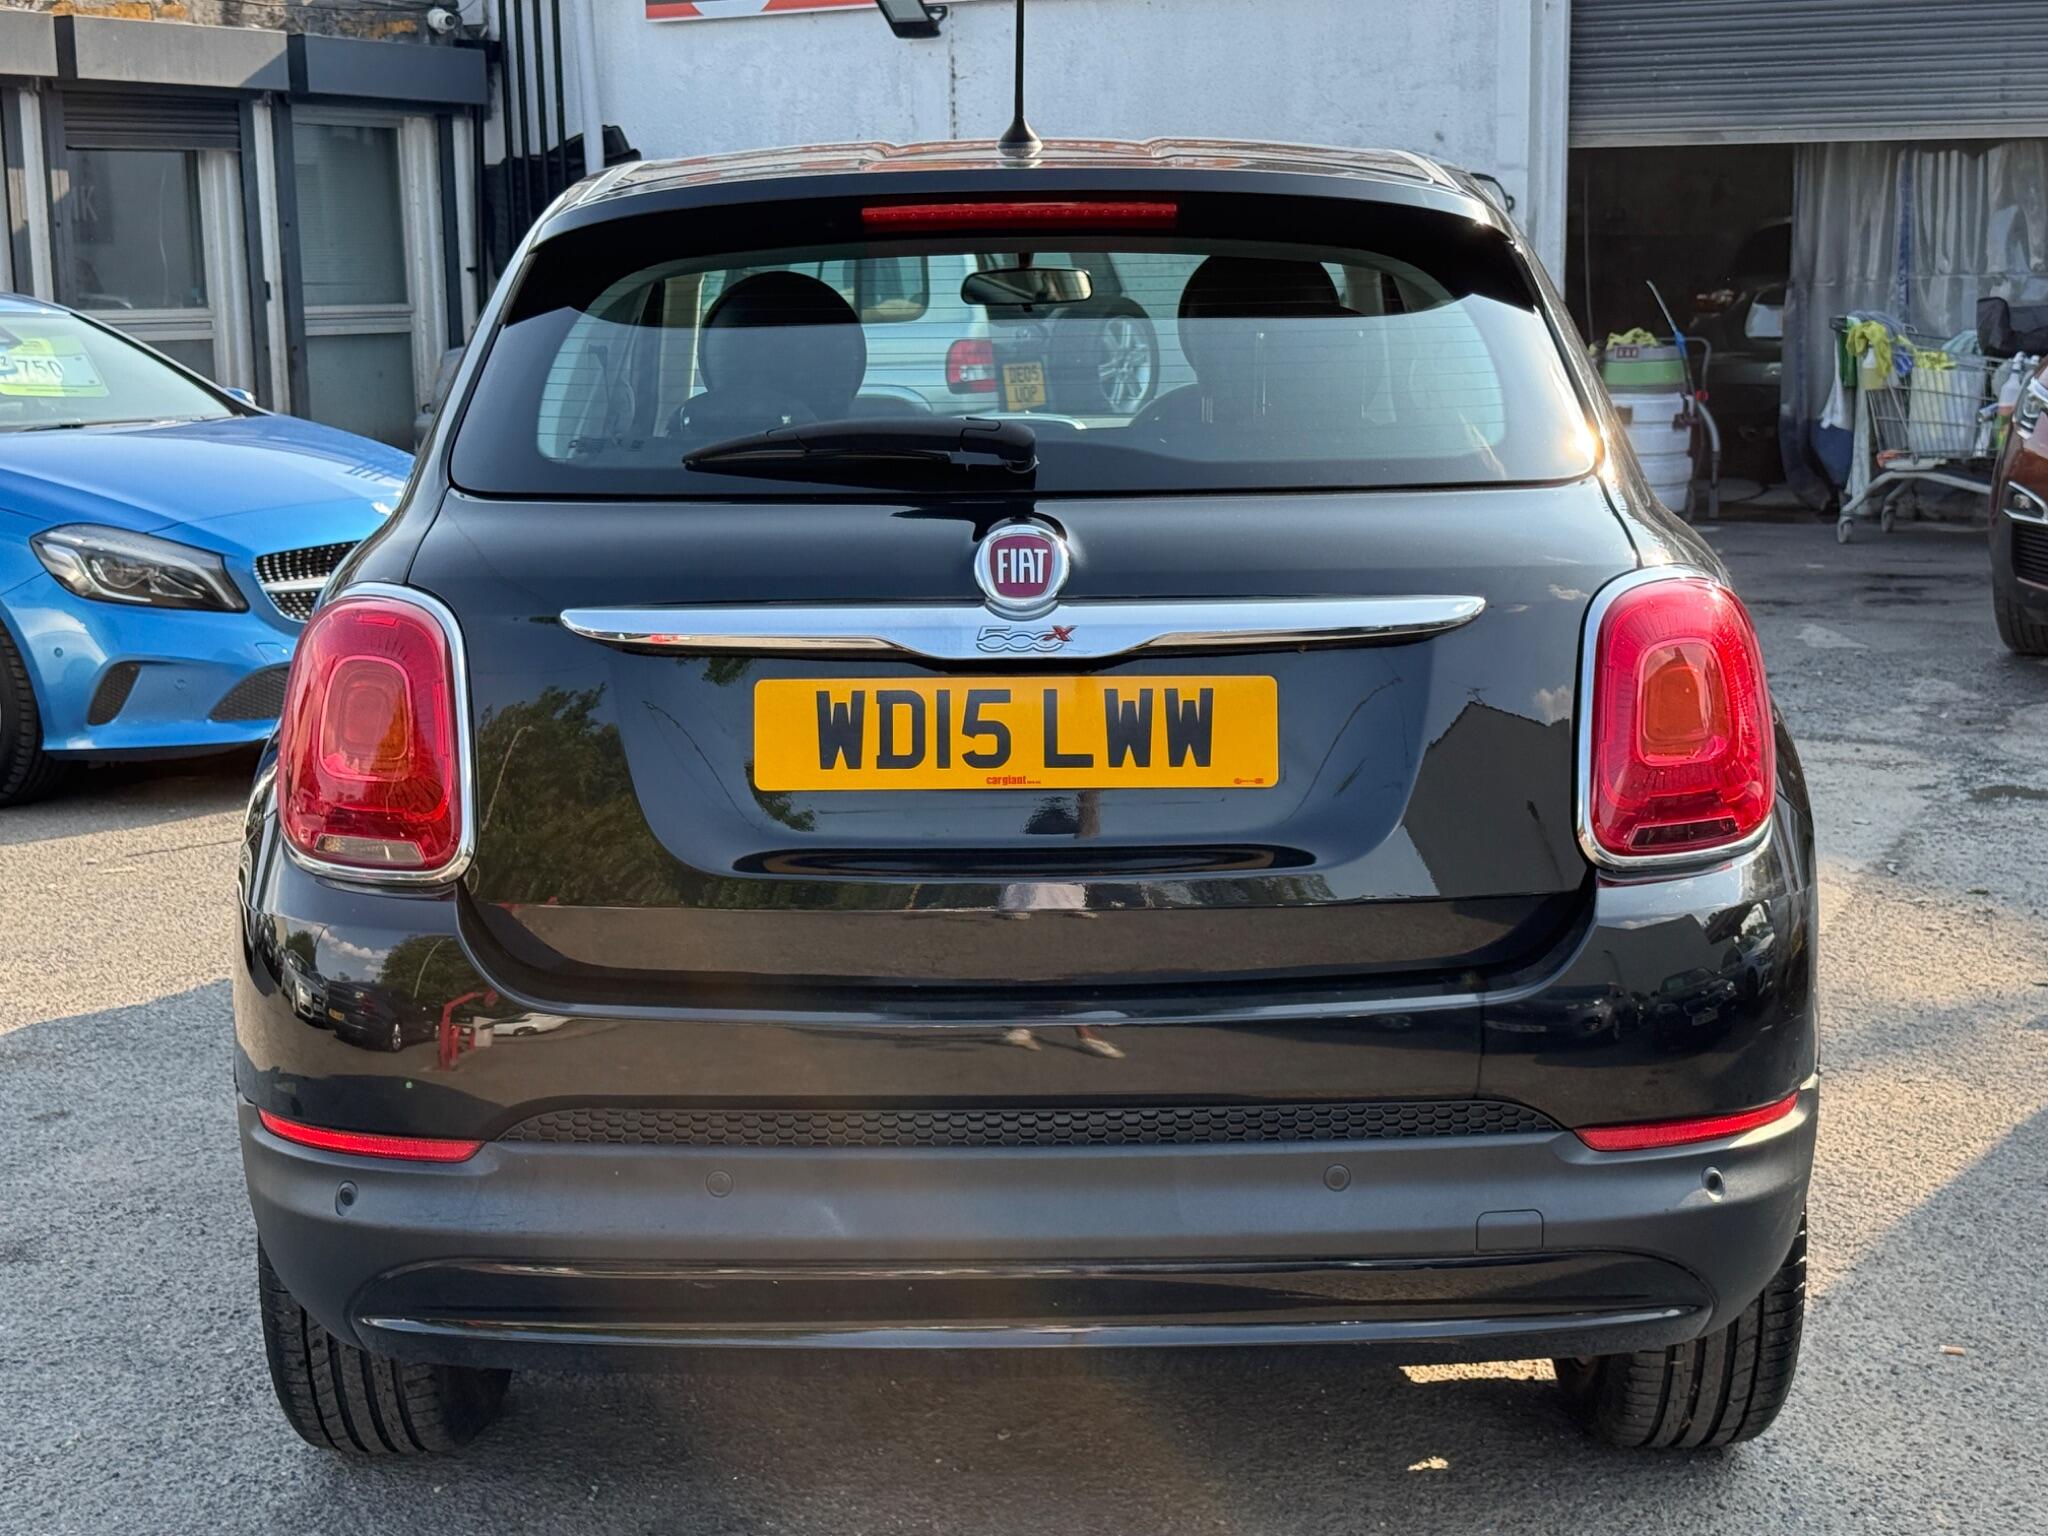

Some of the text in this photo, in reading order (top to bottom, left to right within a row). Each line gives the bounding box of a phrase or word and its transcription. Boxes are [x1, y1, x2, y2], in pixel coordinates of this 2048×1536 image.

[997, 548, 1048, 584] FIAT
[816, 688, 1214, 770] WD15 LWW
